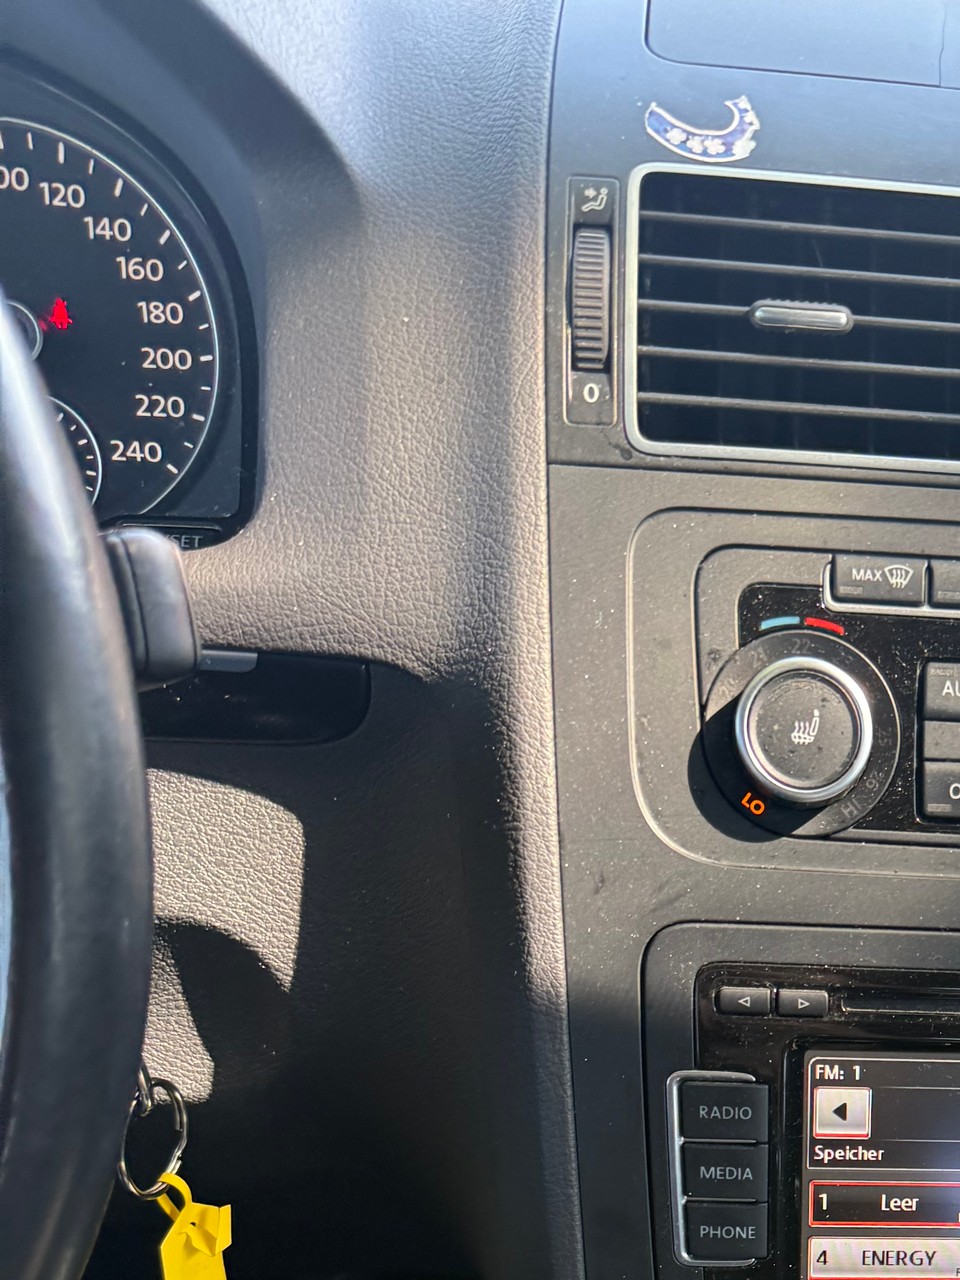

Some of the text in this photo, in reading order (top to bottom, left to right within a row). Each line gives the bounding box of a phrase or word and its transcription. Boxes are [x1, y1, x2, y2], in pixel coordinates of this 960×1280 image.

[39, 182, 85, 208] 120
[83, 216, 131, 241] 140
[116, 256, 164, 282] 160
[137, 301, 184, 325] 180
[141, 347, 192, 370] 200
[583, 383, 600, 404] 0
[135, 394, 185, 418] 220
[110, 440, 162, 463] 240
[851, 567, 883, 583] MAX
[740, 792, 766, 816] LO
[815, 1064, 861, 1081] FM: 1
[699, 1106, 752, 1120] RADIO
[814, 1145, 885, 1163] Speicher
[700, 1166, 753, 1180] MEDIA
[818, 1193, 828, 1210] 1
[881, 1194, 919, 1211] Leer
[700, 1226, 756, 1239] PHONE
[816, 1250, 828, 1265] 4
[862, 1250, 937, 1266] ENERGY
